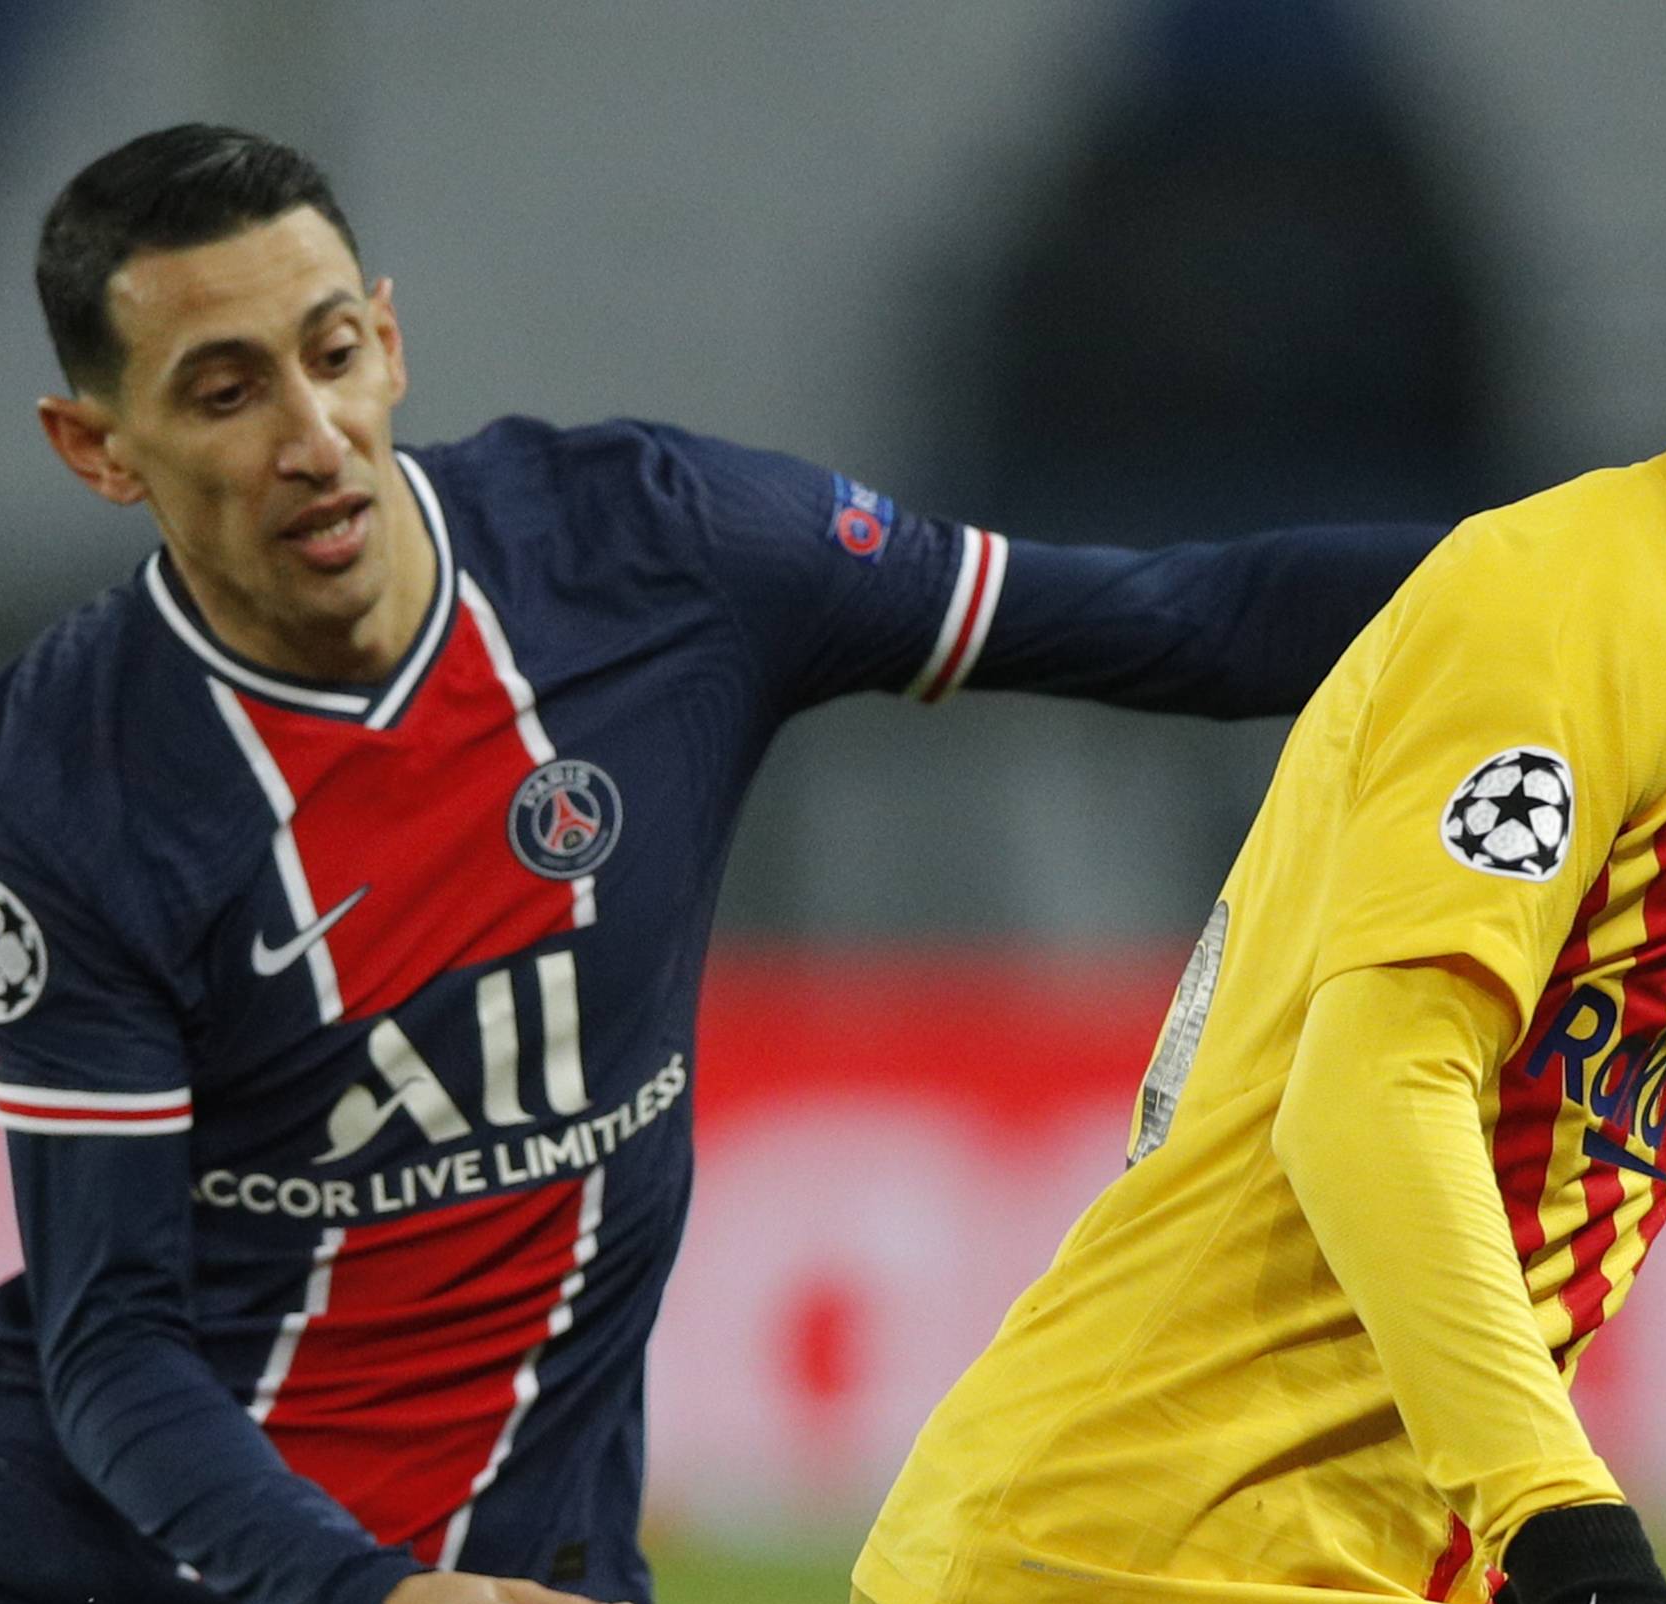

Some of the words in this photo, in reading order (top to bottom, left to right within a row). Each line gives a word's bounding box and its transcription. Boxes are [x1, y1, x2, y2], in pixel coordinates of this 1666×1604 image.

[191, 1168, 360, 1219] CCOR
[370, 1150, 487, 1214] LIVE
[493, 1052, 687, 1187] LIMITLESS
